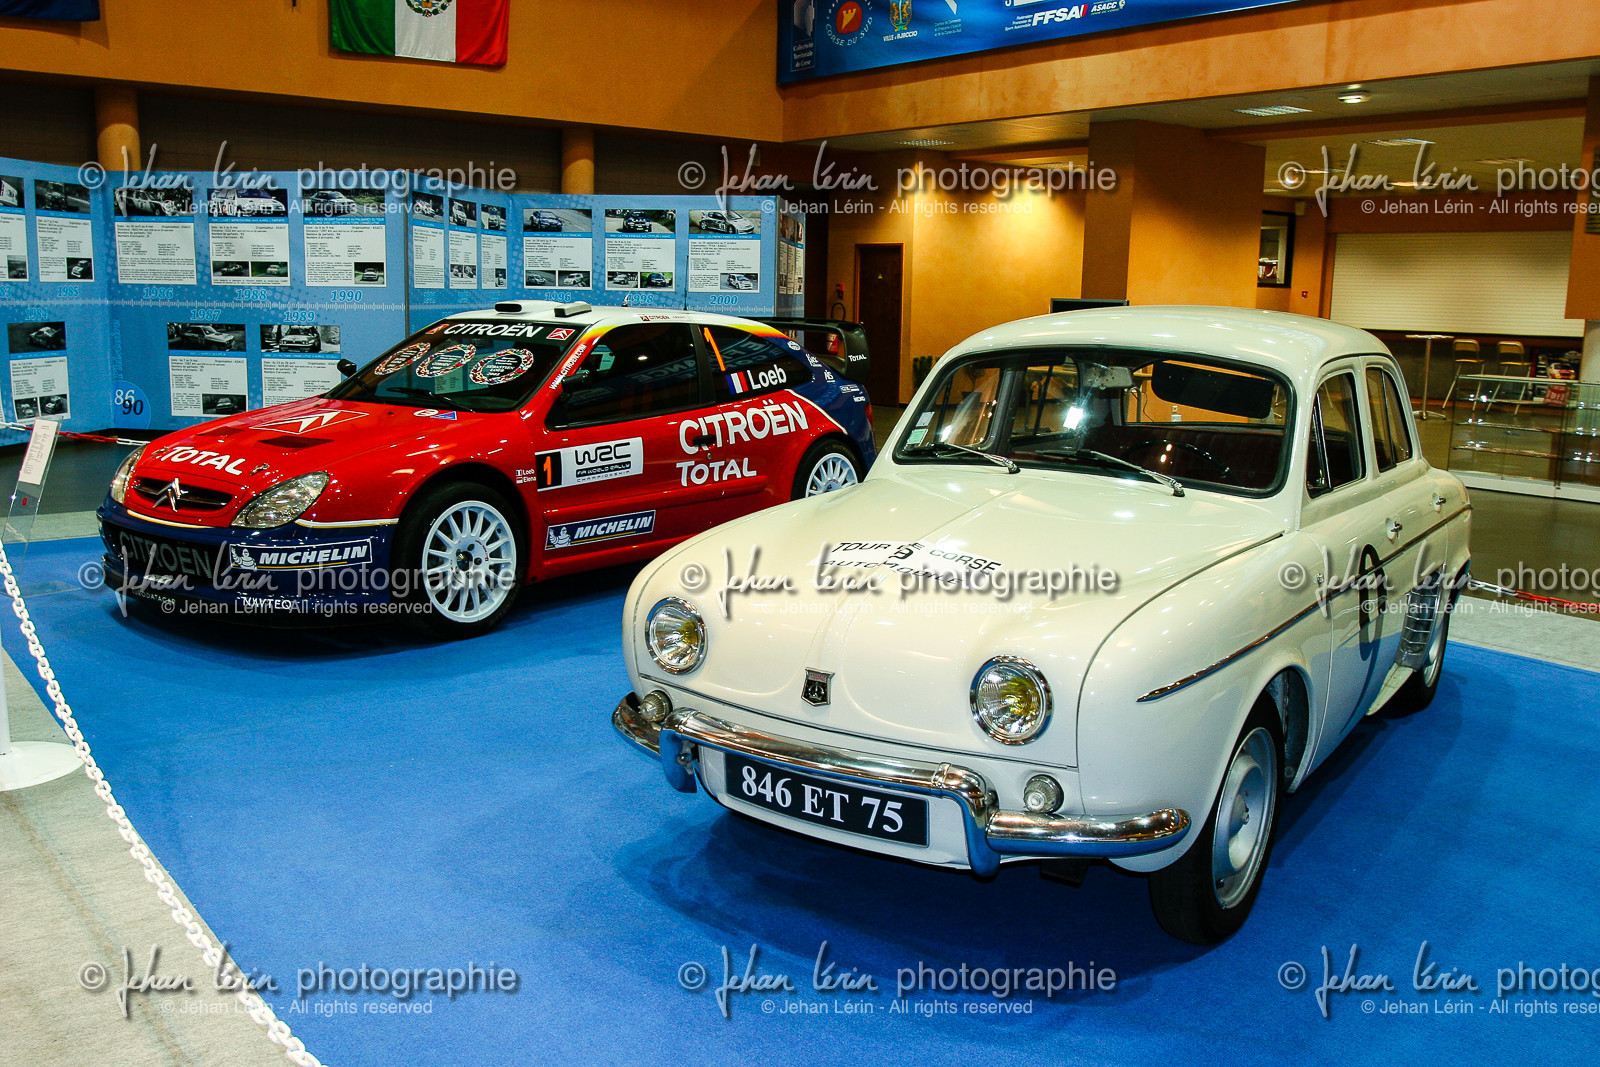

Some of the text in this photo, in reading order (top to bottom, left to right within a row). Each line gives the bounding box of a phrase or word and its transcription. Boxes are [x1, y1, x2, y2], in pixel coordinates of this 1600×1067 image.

[57, 285, 80, 298] 1985
[143, 286, 174, 299] 1986
[235, 288, 268, 301] 1988
[331, 289, 363, 302] 1990
[543, 291, 572, 302] 1996
[709, 294, 738, 305] 2000
[190, 308, 222, 320] 1987
[283, 311, 315, 323] 1989
[443, 323, 544, 338] CITROËN
[703, 326, 726, 372] 1
[848, 353, 867, 362] TOTAL
[747, 363, 787, 390] Loeb
[114, 389, 135, 406] 86
[122, 399, 144, 416] 90
[678, 399, 809, 455] CITROËN
[161, 446, 247, 475] TOTAL
[574, 442, 632, 466] WRC
[522, 468, 535, 476] Loeb
[523, 475, 536, 483] Elena
[543, 455, 552, 486] 1
[676, 457, 757, 487] TOTAL
[573, 516, 653, 539] MICHELIN
[259, 545, 368, 565] MICHELIN
[832, 542, 891, 553] TOUR
[929, 549, 1001, 575] CORSE
[741, 766, 903, 833] 846 ET 75
